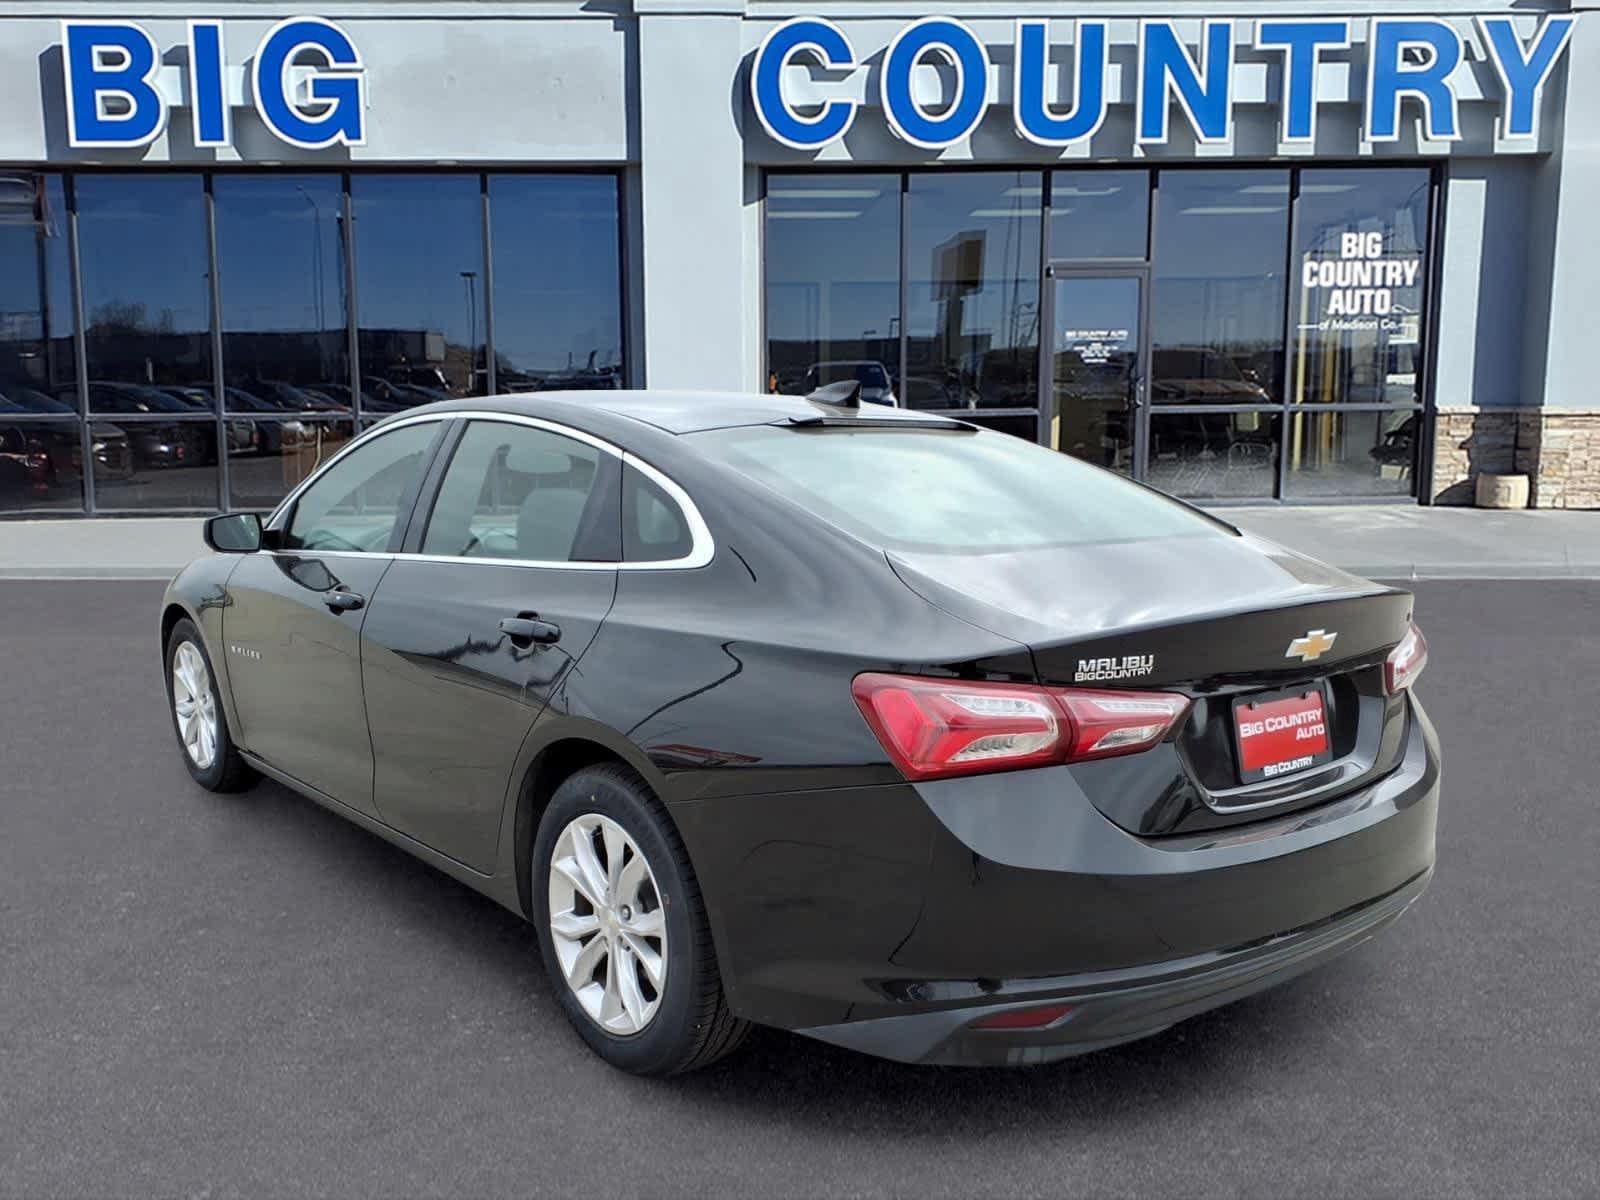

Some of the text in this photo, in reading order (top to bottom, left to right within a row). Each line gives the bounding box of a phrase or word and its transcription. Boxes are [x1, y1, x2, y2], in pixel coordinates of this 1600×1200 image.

[61, 14, 1576, 150] BIG COUNTRY
[1341, 232, 1382, 258] BIG
[1303, 260, 1419, 287] COUNTRY
[1328, 290, 1391, 315] AUTO
[1319, 320, 1329, 330] of
[1332, 320, 1377, 330] Madison
[1078, 654, 1154, 672] MALIBU
[1240, 708, 1322, 738] BIG COUNTRY
[1296, 724, 1325, 740] AUTO
[1264, 756, 1312, 776] BIG COUNTRY
